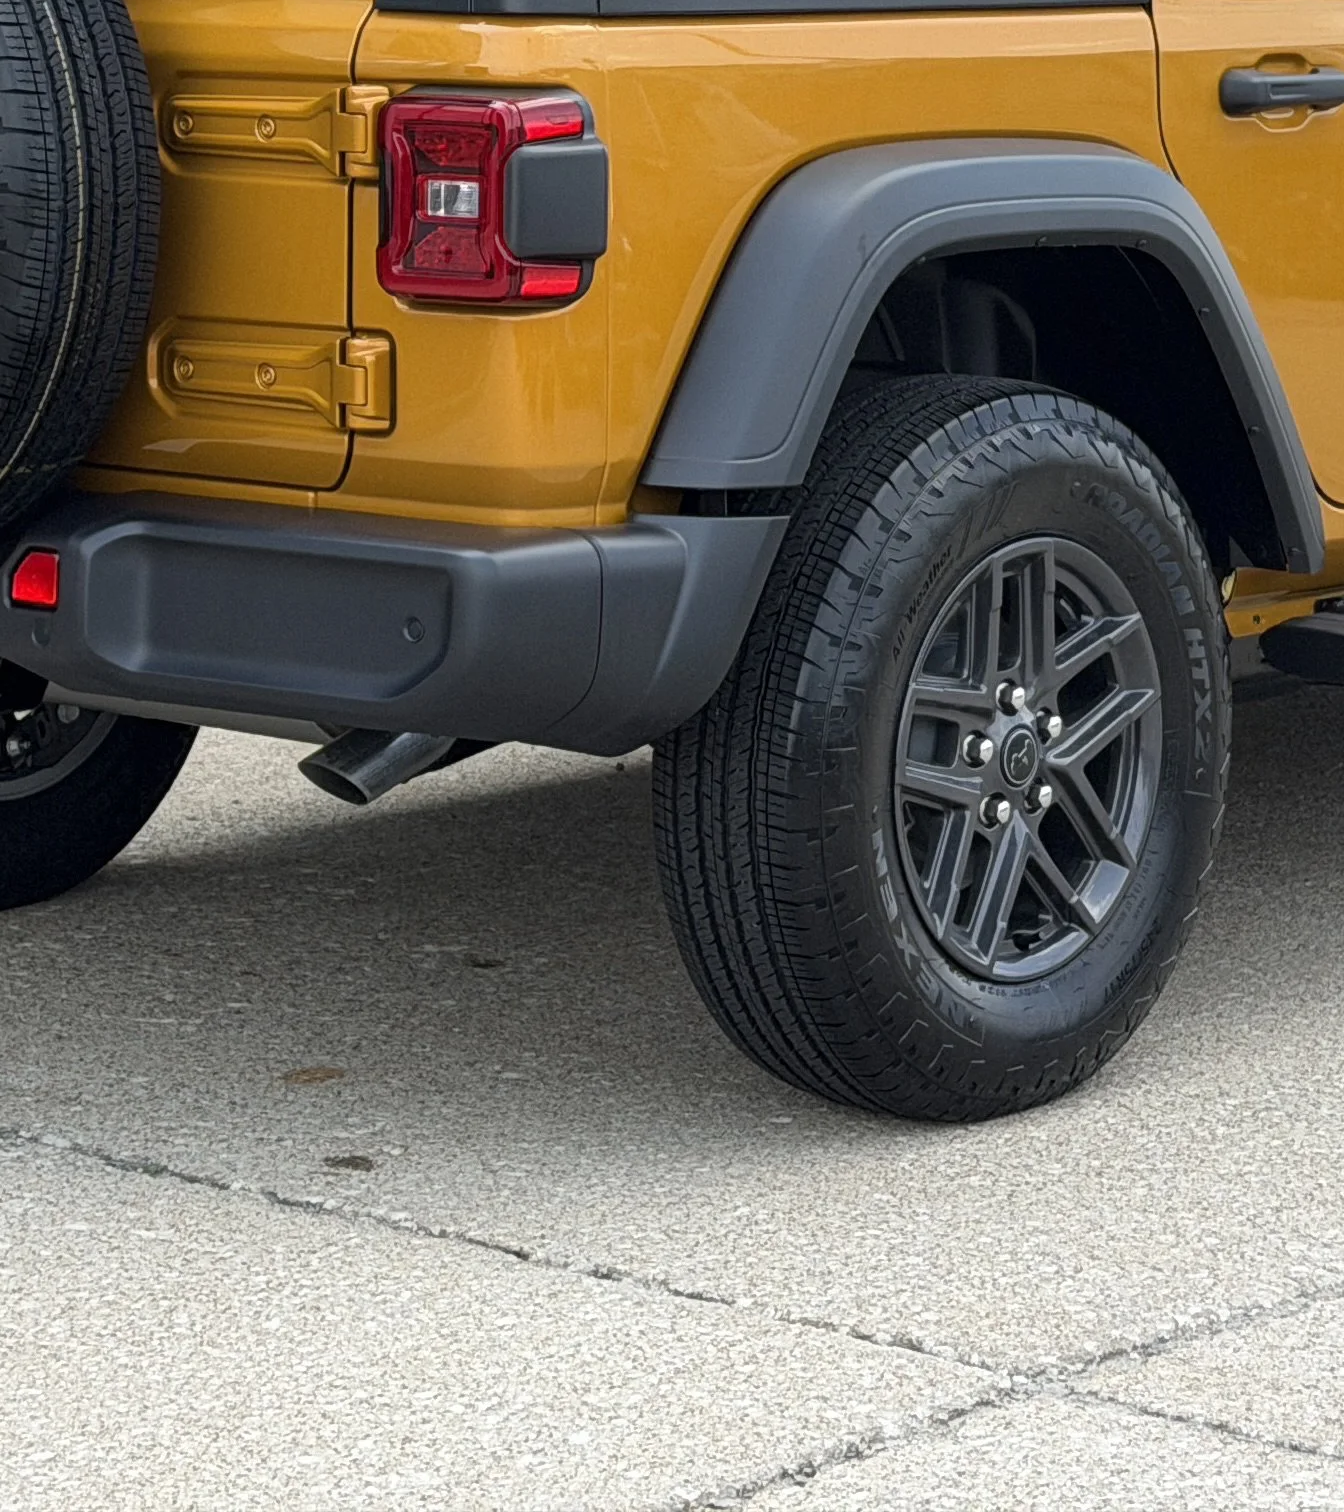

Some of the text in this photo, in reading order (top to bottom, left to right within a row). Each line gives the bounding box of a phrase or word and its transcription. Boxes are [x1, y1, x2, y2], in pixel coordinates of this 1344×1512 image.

[892, 543, 954, 664] All Weather
[1086, 482, 1196, 616] ROADIAN
[871, 827, 967, 1029] NEXEN
